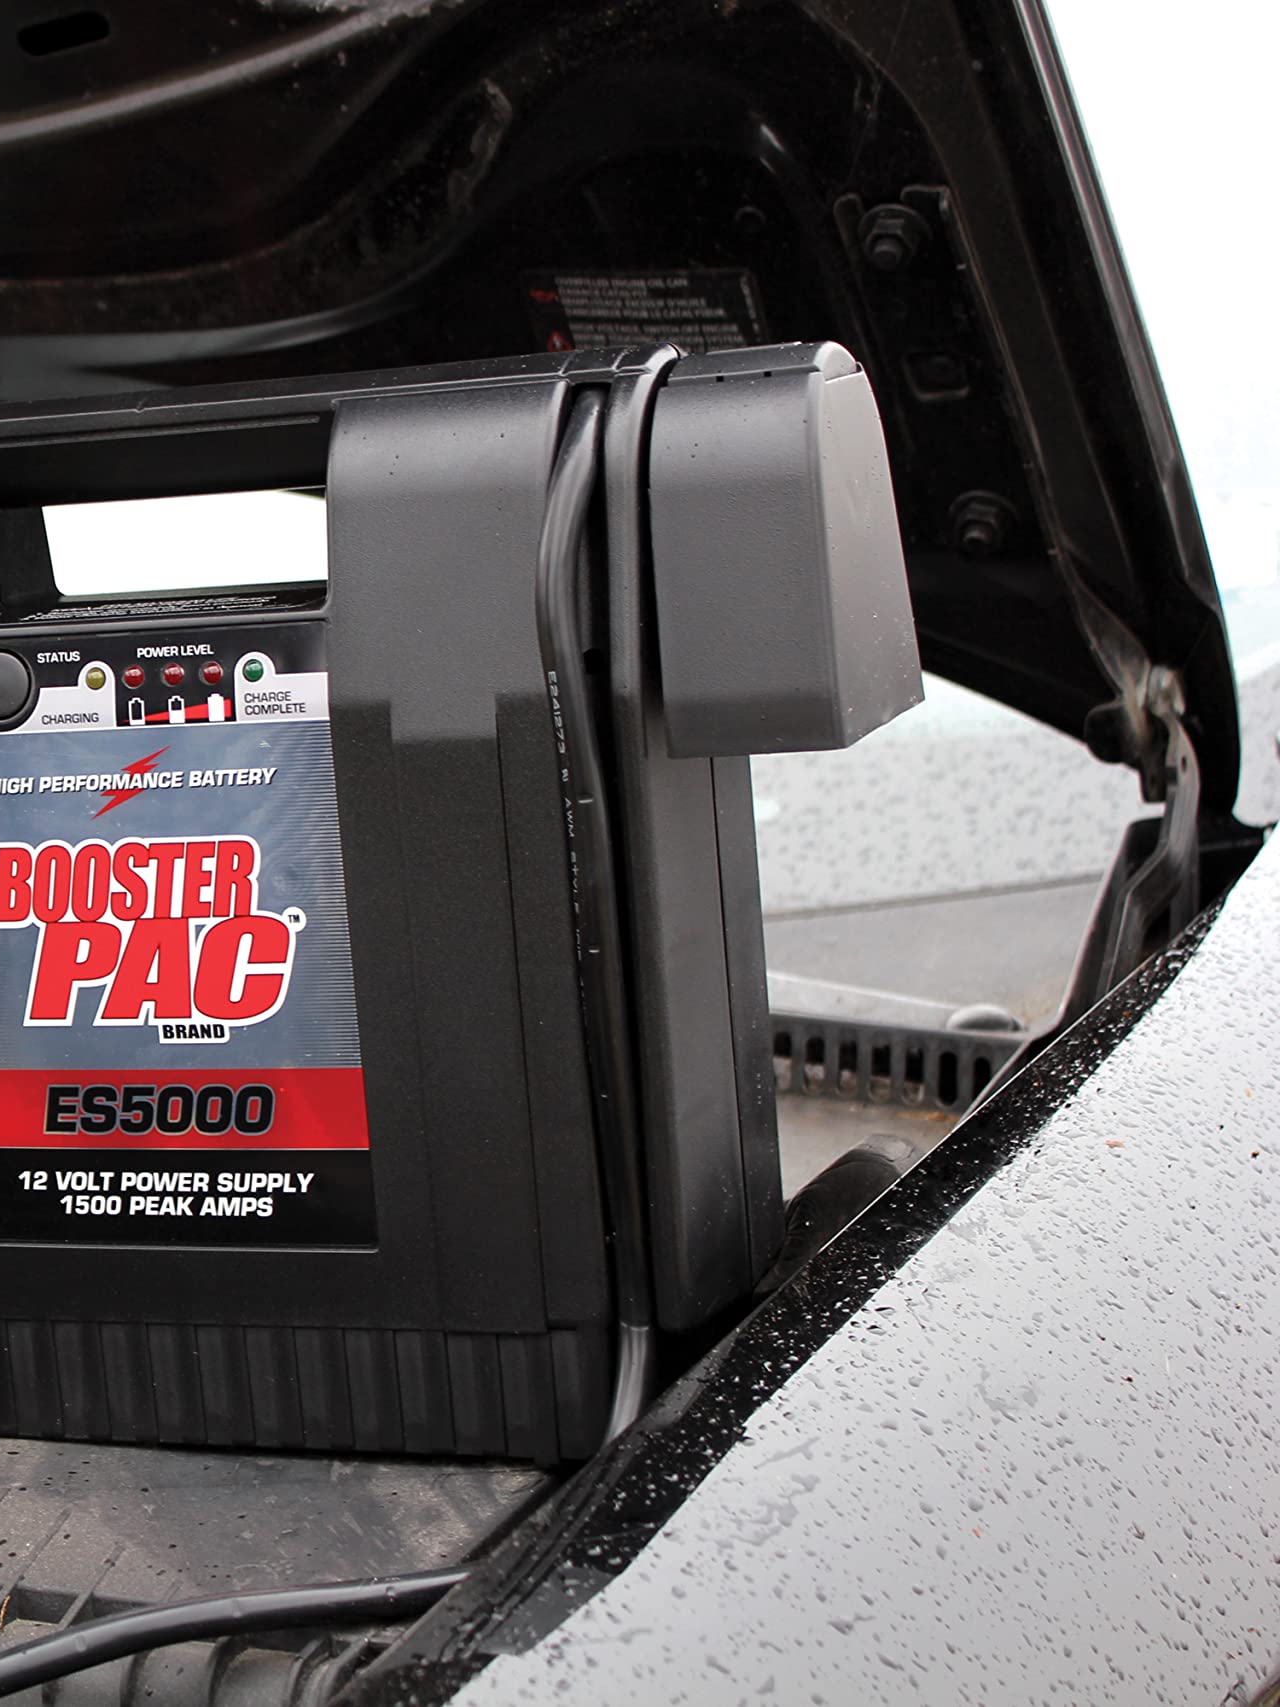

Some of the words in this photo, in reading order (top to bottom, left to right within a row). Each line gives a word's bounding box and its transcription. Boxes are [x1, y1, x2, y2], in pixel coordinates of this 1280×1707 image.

[36, 651, 81, 664] STATUS
[136, 646, 179, 659] POWER
[180, 644, 214, 657] LEVEL
[244, 691, 292, 704] CHARGE
[41, 712, 100, 726] CHARGING
[245, 702, 306, 716] COMPLETE
[38, 770, 183, 793] PERFORMANCE
[188, 767, 278, 787] BATTERY
[564, 797, 575, 838] AWM
[28, 914, 291, 1021] PAC
[162, 1023, 226, 1040] BRAND
[42, 1083, 277, 1136] ES5000
[18, 1170, 49, 1191] 12
[55, 1171, 115, 1192] VOLT
[120, 1172, 210, 1193] POWER
[216, 1172, 315, 1194] SUPPLY
[59, 1195, 122, 1216] 1500
[128, 1196, 195, 1217] PEAK
[199, 1196, 274, 1218] AMPS
